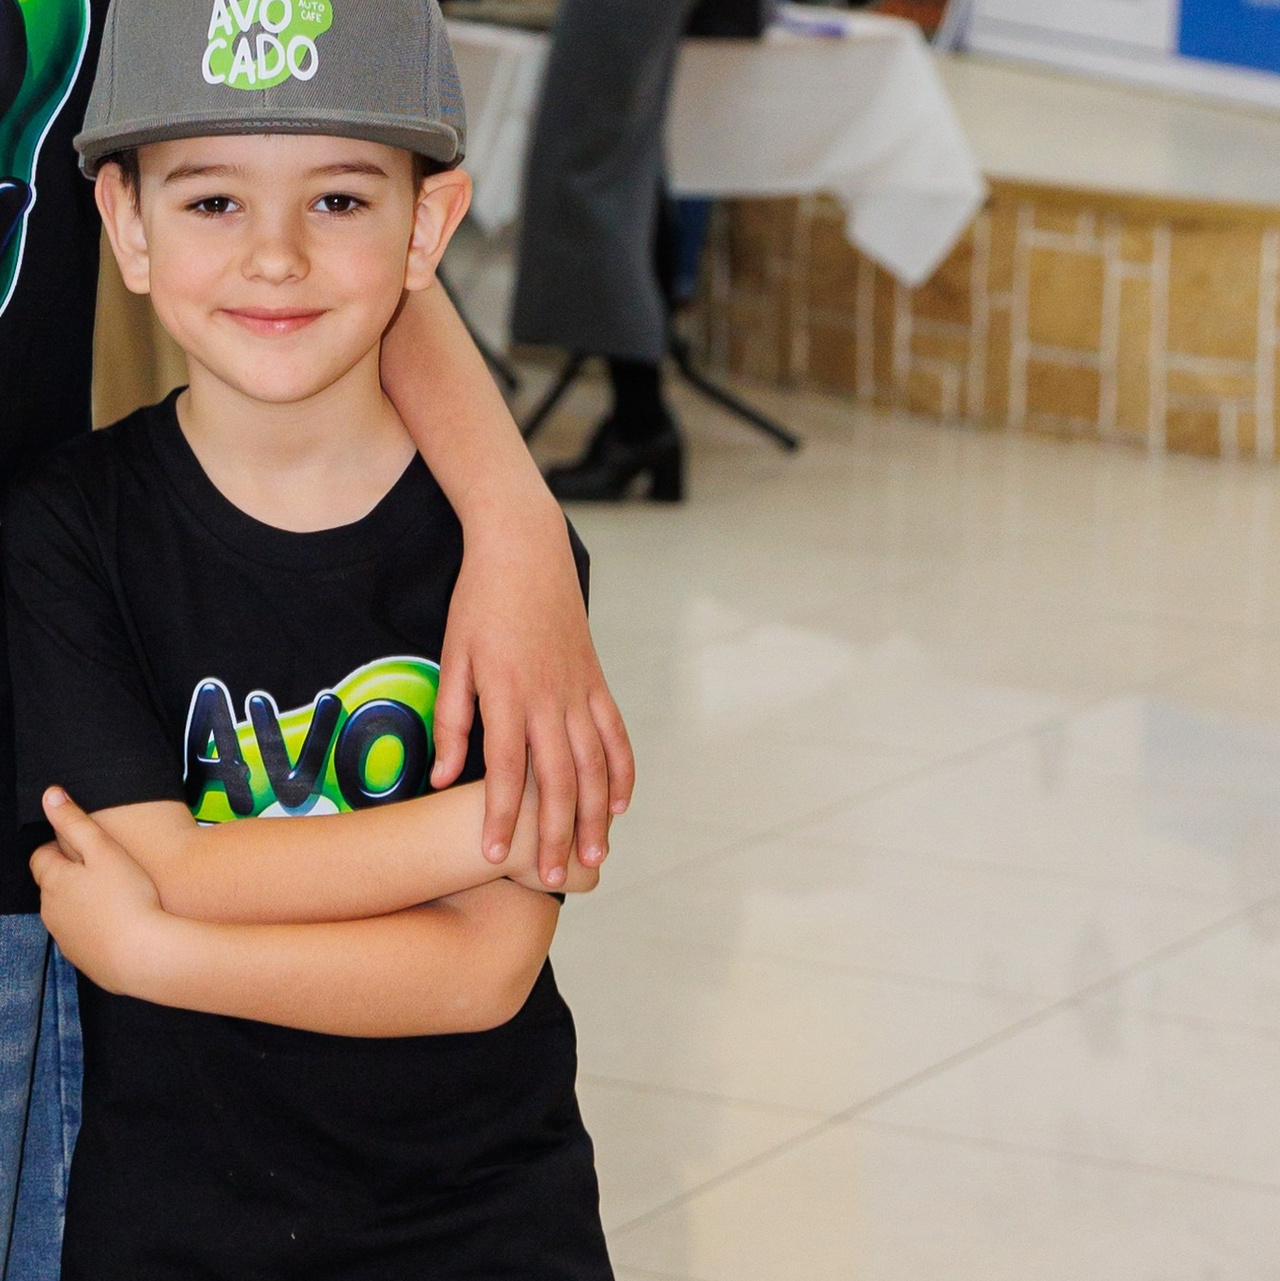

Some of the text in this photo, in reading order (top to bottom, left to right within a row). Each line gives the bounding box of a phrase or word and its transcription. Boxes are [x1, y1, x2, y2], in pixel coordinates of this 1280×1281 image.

[301, 12, 322, 23] CAFE
[201, 33, 319, 85] CADO
[184, 680, 428, 816] AVO
